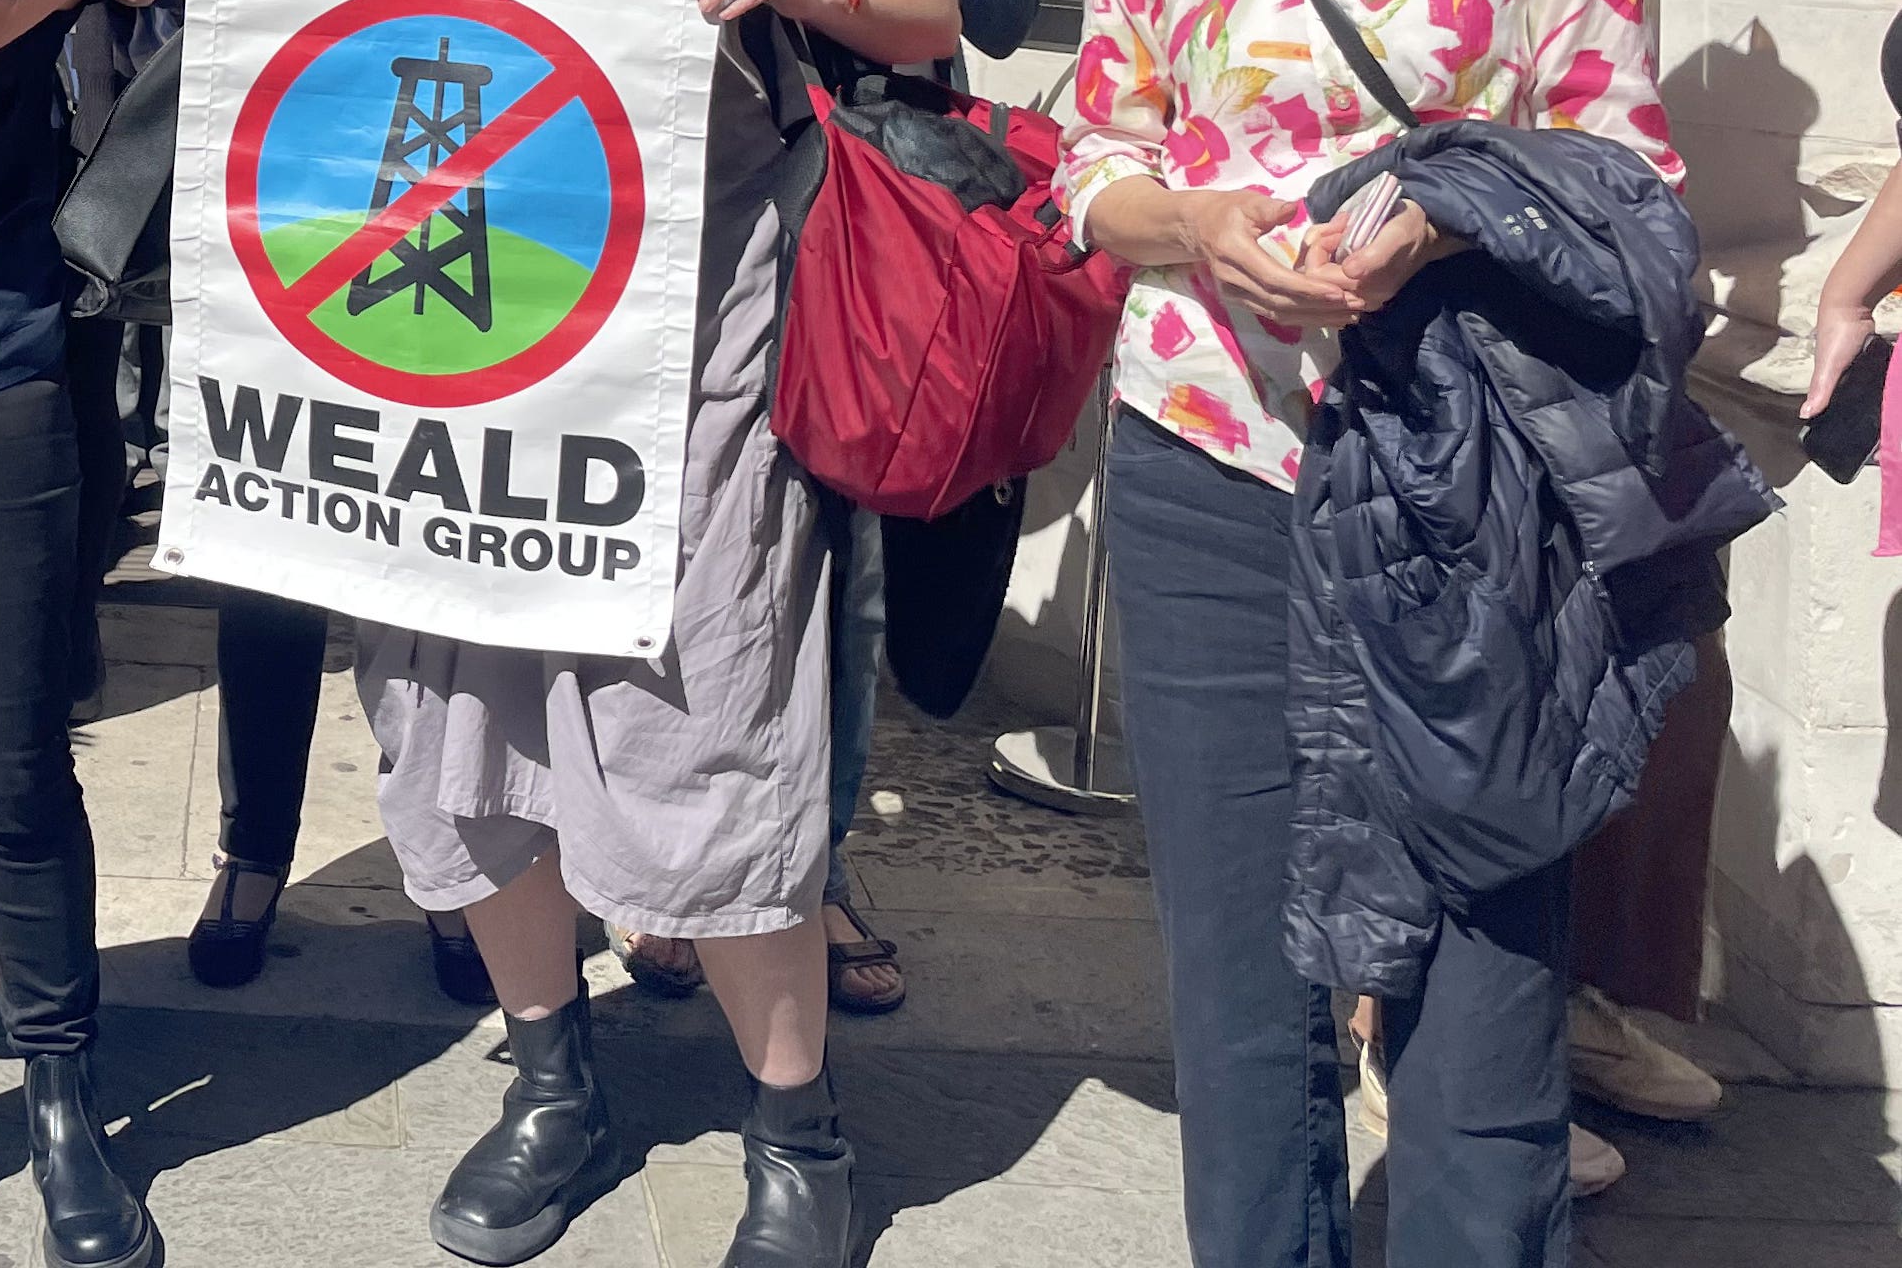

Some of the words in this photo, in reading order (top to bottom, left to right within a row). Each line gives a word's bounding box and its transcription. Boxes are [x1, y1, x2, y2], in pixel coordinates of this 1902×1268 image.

[198, 375, 646, 527] WEALD
[193, 462, 402, 547] ACTION
[423, 516, 642, 581] GROUP
